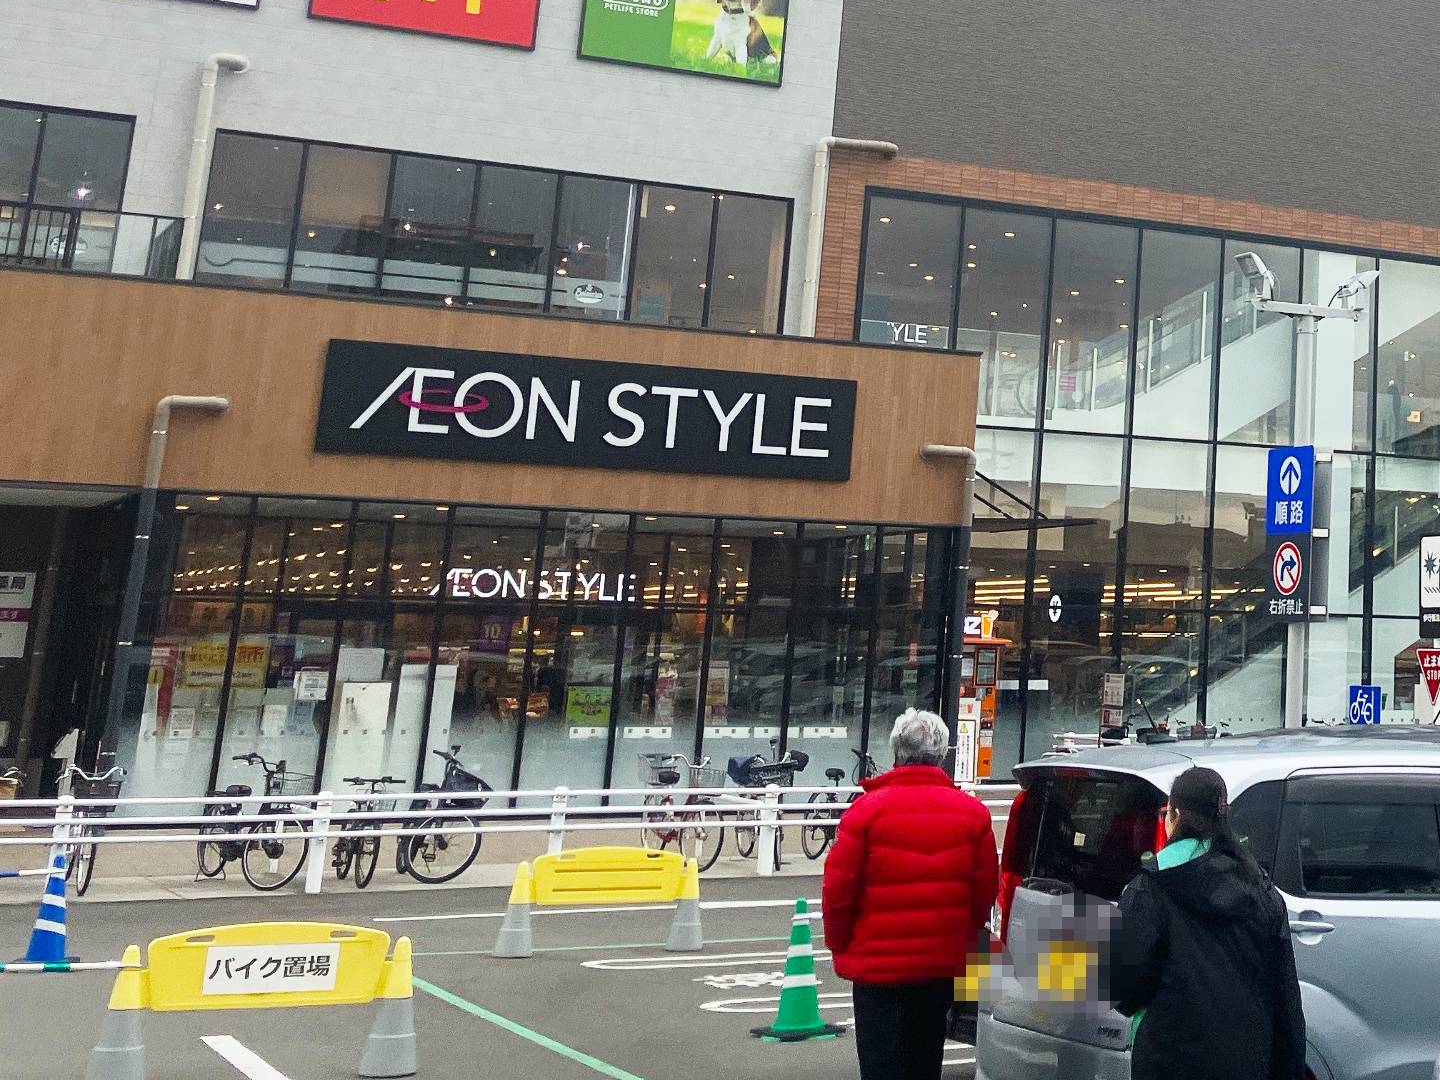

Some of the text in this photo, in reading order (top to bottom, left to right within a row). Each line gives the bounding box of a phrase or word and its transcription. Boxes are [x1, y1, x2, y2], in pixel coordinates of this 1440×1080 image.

[604, 3, 659, 17] PETLIFE STORE
[602, 382, 833, 458] STYLE
[1274, 500, 1304, 525] 順路
[1268, 599, 1304, 615] 右折禁止
[208, 954, 331, 980] バイク置場
